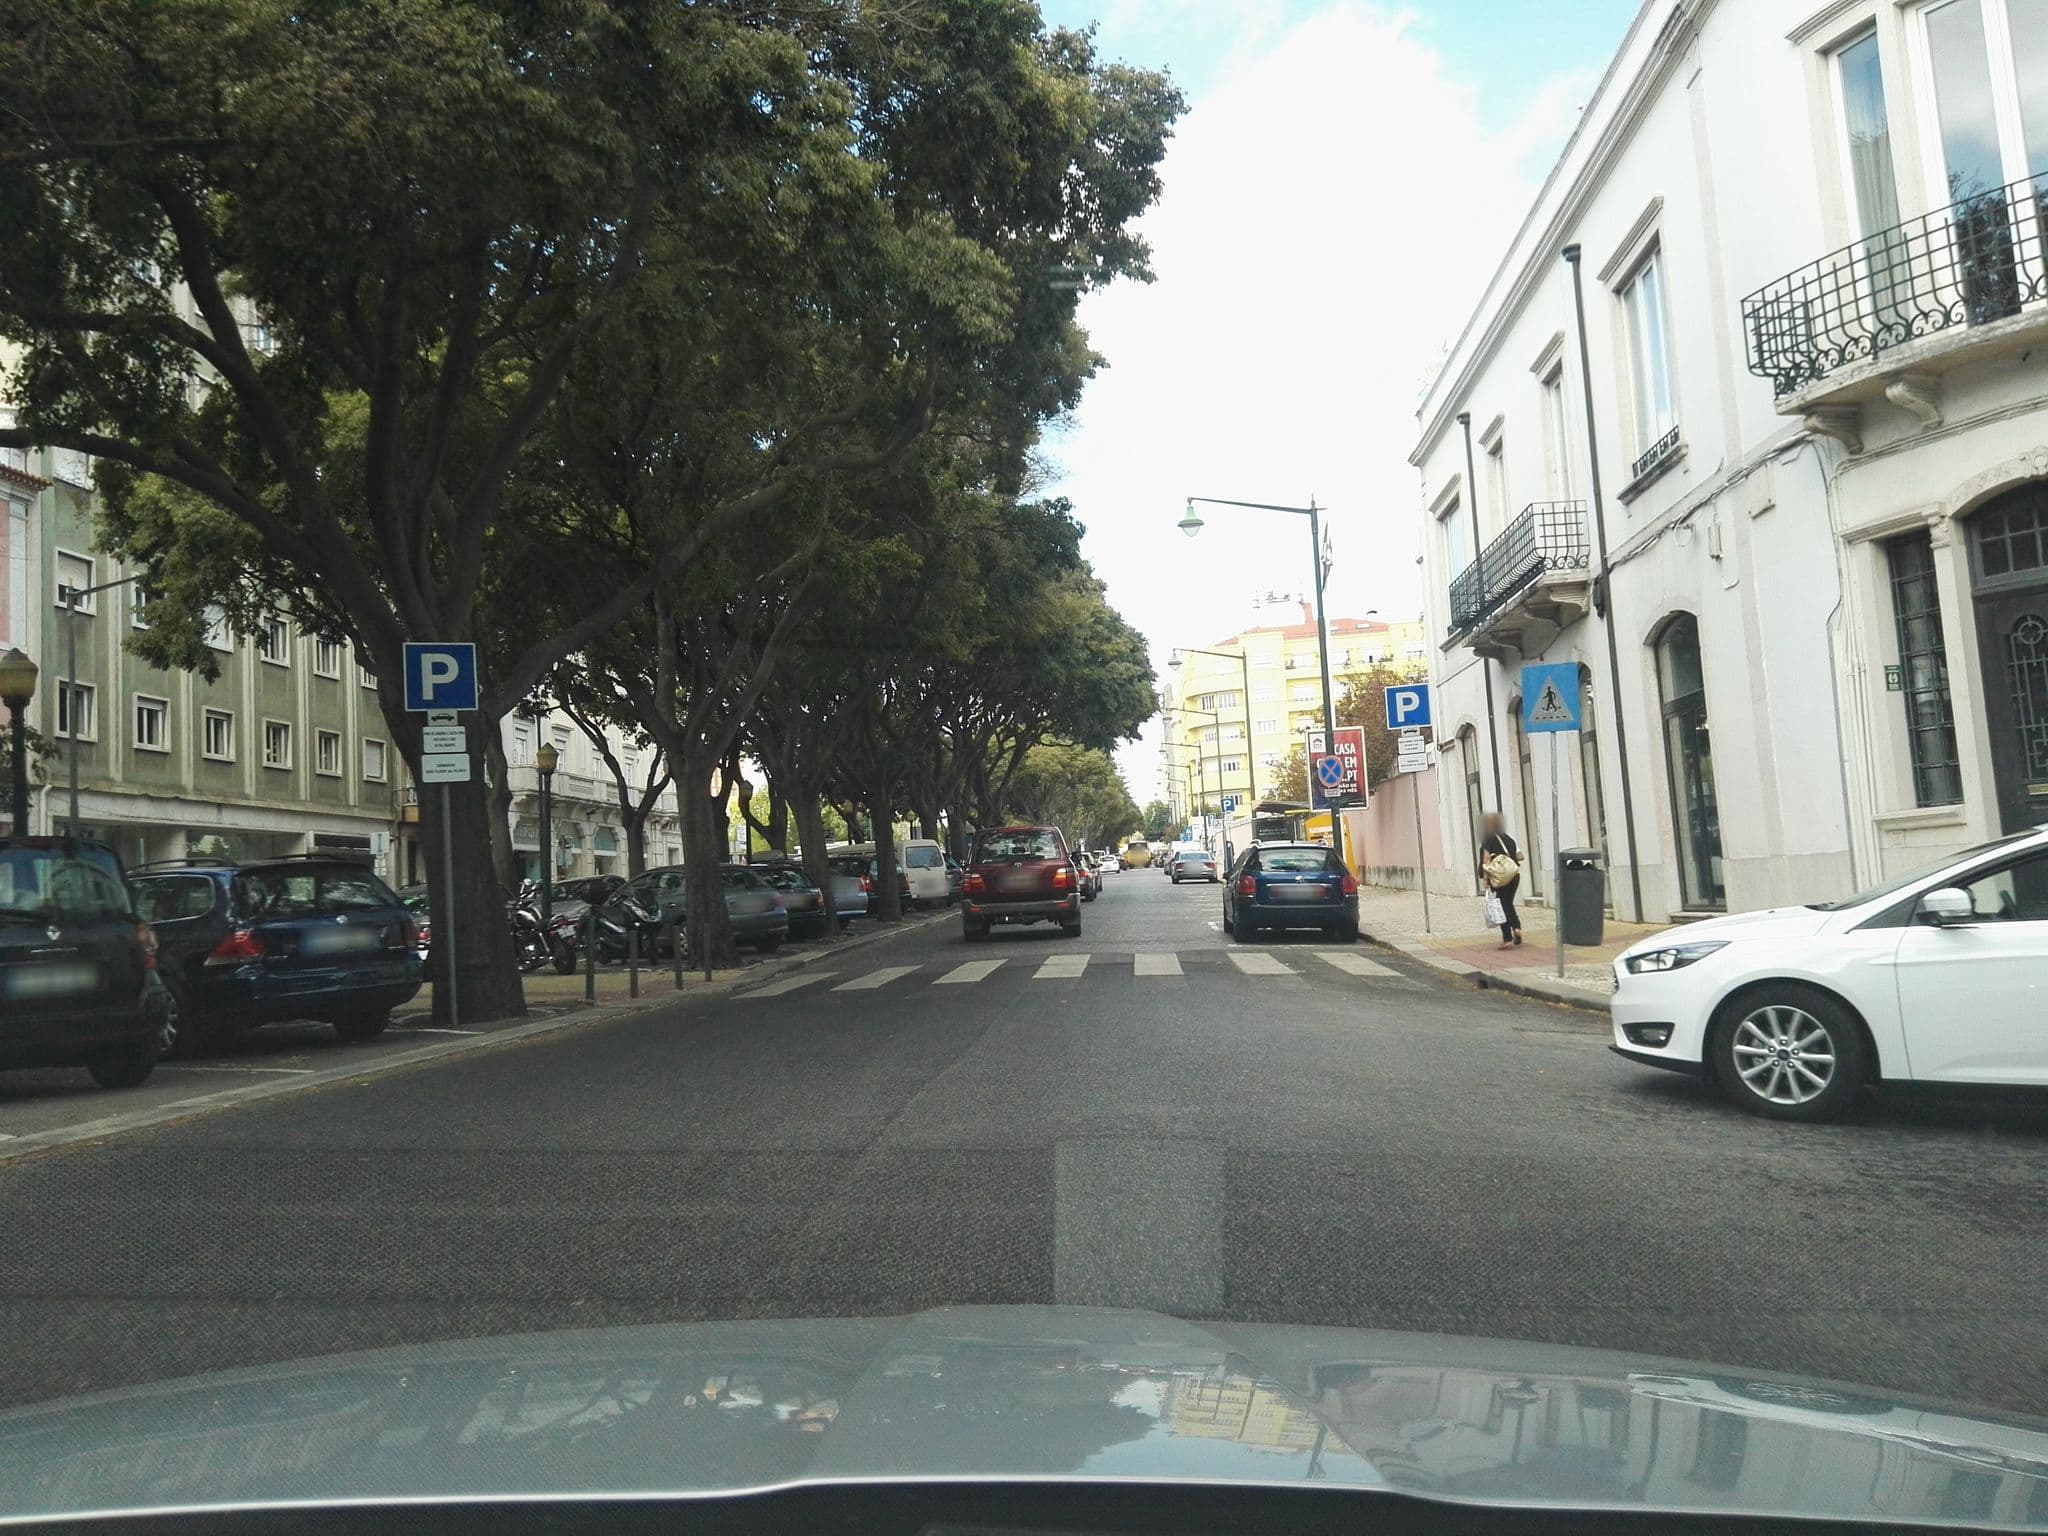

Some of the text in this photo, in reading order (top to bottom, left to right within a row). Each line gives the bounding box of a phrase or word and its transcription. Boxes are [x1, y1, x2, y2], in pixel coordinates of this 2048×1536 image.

[421, 653, 459, 701] P
[1395, 691, 1420, 722] P
[1334, 743, 1356, 754] CASA
[1223, 800, 1231, 811] P
